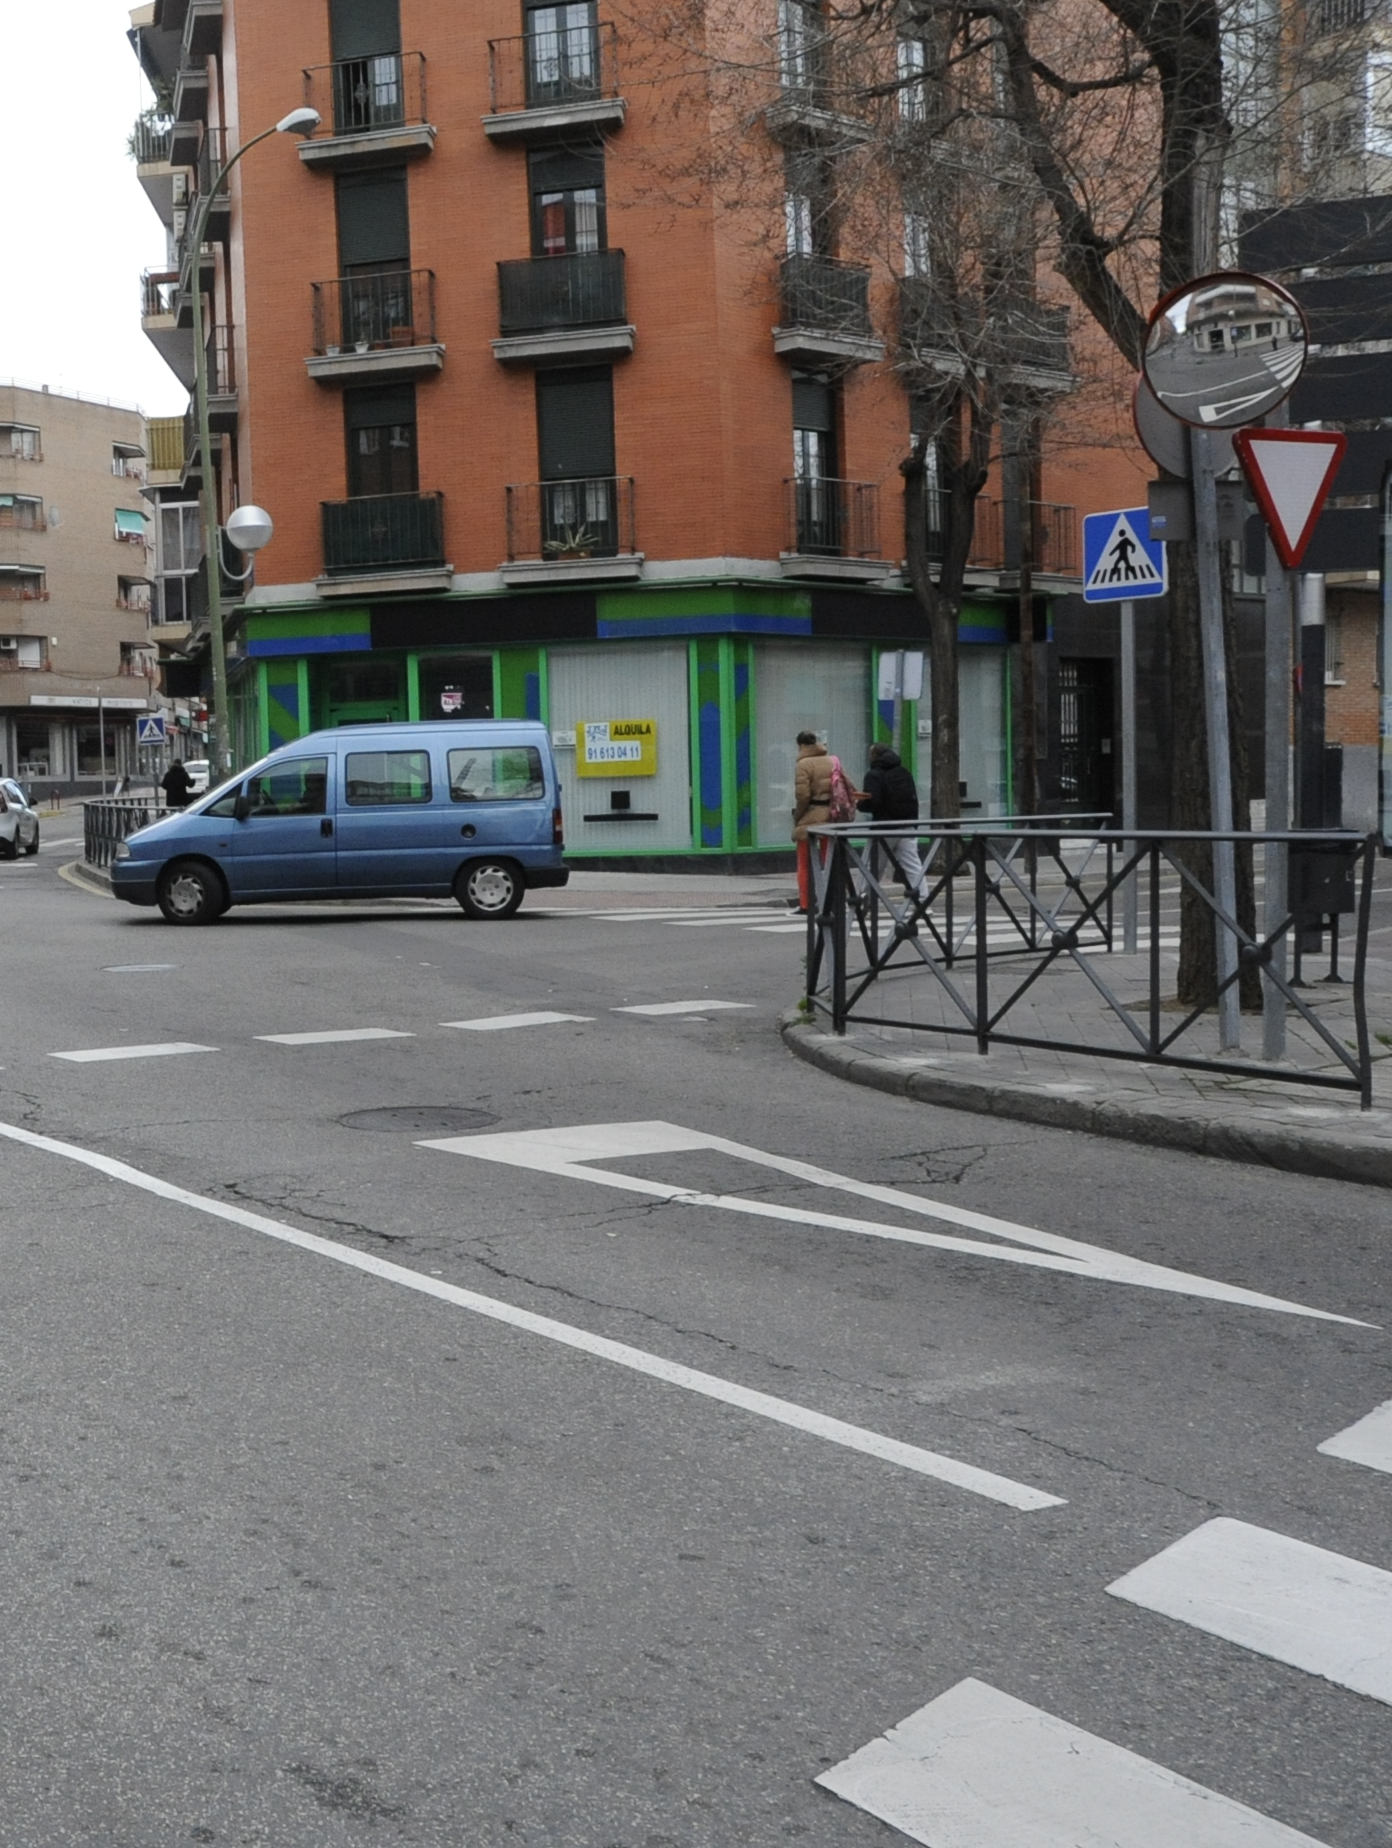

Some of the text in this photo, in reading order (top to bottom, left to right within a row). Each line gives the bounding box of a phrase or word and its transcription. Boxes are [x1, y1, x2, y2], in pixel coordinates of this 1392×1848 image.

[613, 723, 652, 736] ALQUILA
[587, 745, 639, 760] 91 613 04 11
